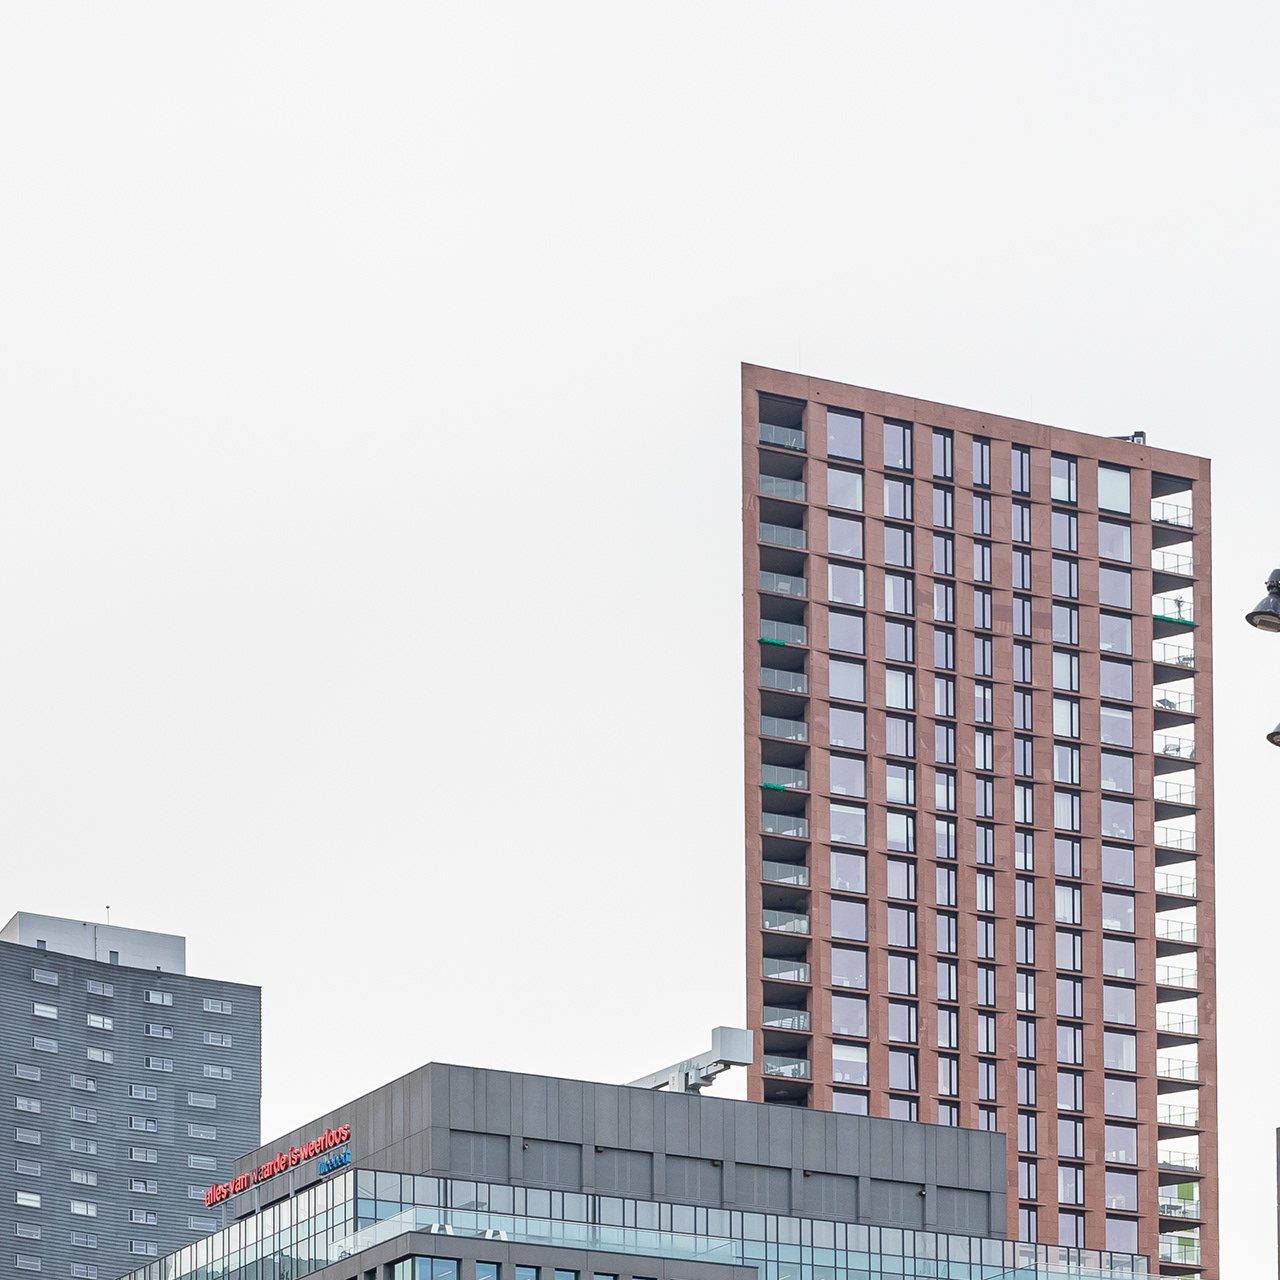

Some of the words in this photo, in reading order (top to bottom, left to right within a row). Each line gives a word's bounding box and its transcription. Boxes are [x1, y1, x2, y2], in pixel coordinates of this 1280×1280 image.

[204, 1183, 229, 1207] alles
[230, 1172, 250, 1194] van
[288, 1146, 300, 1167] is
[300, 1123, 351, 1160] weerloos
